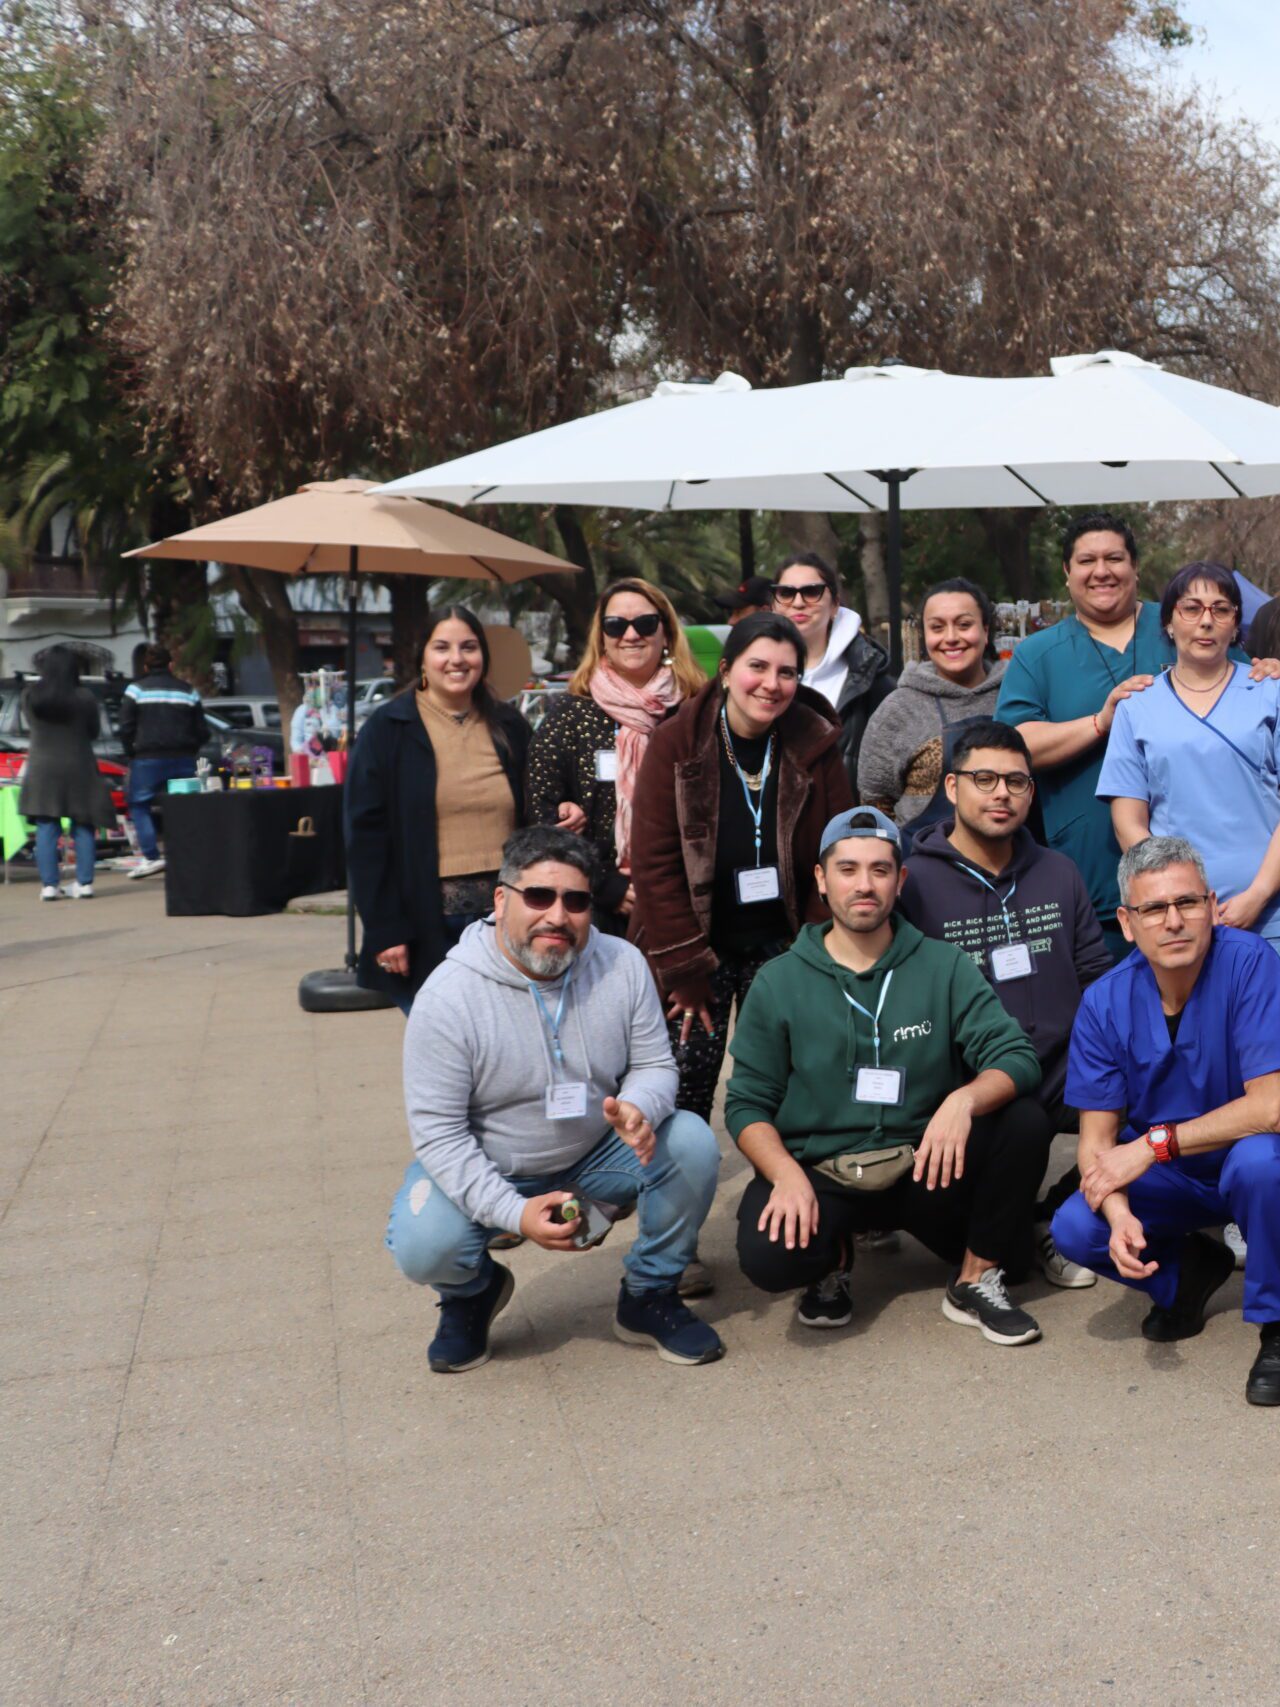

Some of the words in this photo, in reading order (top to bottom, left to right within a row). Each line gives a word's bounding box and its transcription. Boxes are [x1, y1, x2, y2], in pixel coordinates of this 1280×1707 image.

[945, 931, 962, 939] RICK
[964, 928, 980, 936] AND
[1026, 916, 1040, 924] AND
[1028, 927, 1042, 935] AND
